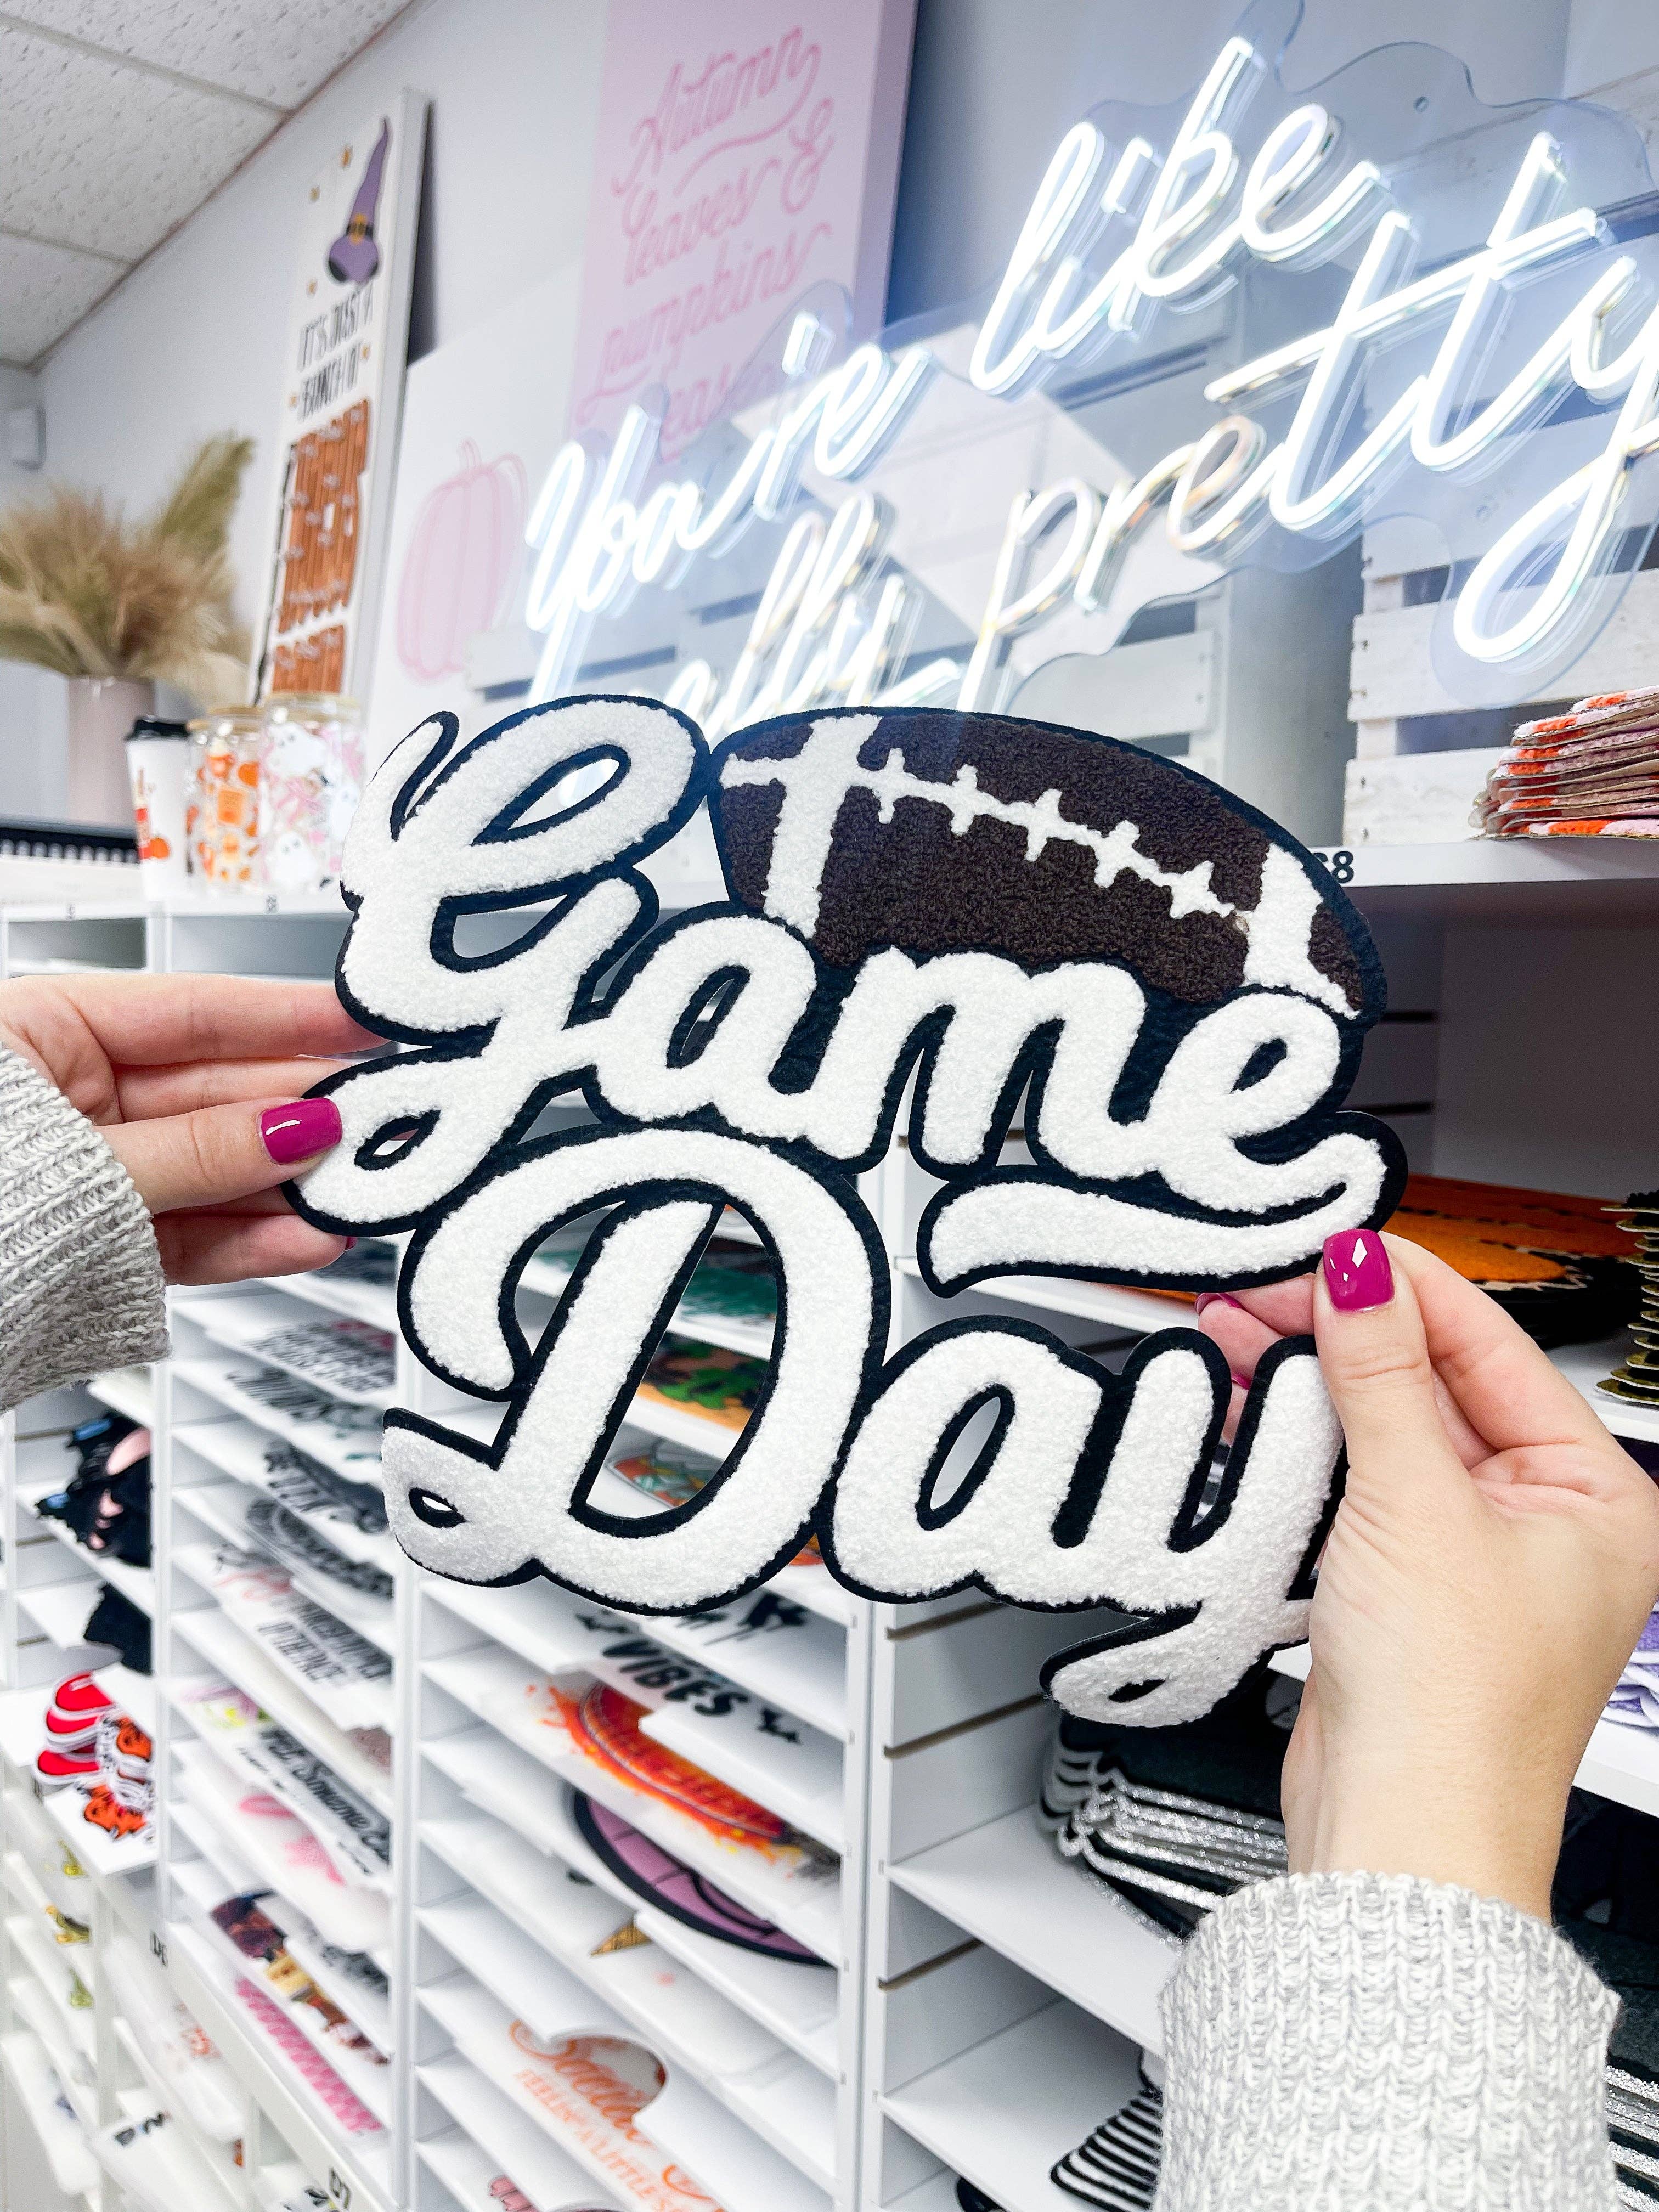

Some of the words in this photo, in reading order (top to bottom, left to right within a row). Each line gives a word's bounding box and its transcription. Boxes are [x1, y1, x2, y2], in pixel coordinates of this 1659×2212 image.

[611, 26, 821, 195] Autumn
[969, 36, 1381, 396] like
[576, 223, 832, 425] pumpkins
[957, 132, 1659, 712] pretty
[285, 695, 1377, 1240] Game
[383, 1126, 1348, 1728] Day
[602, 1638, 749, 1717] VIBES
